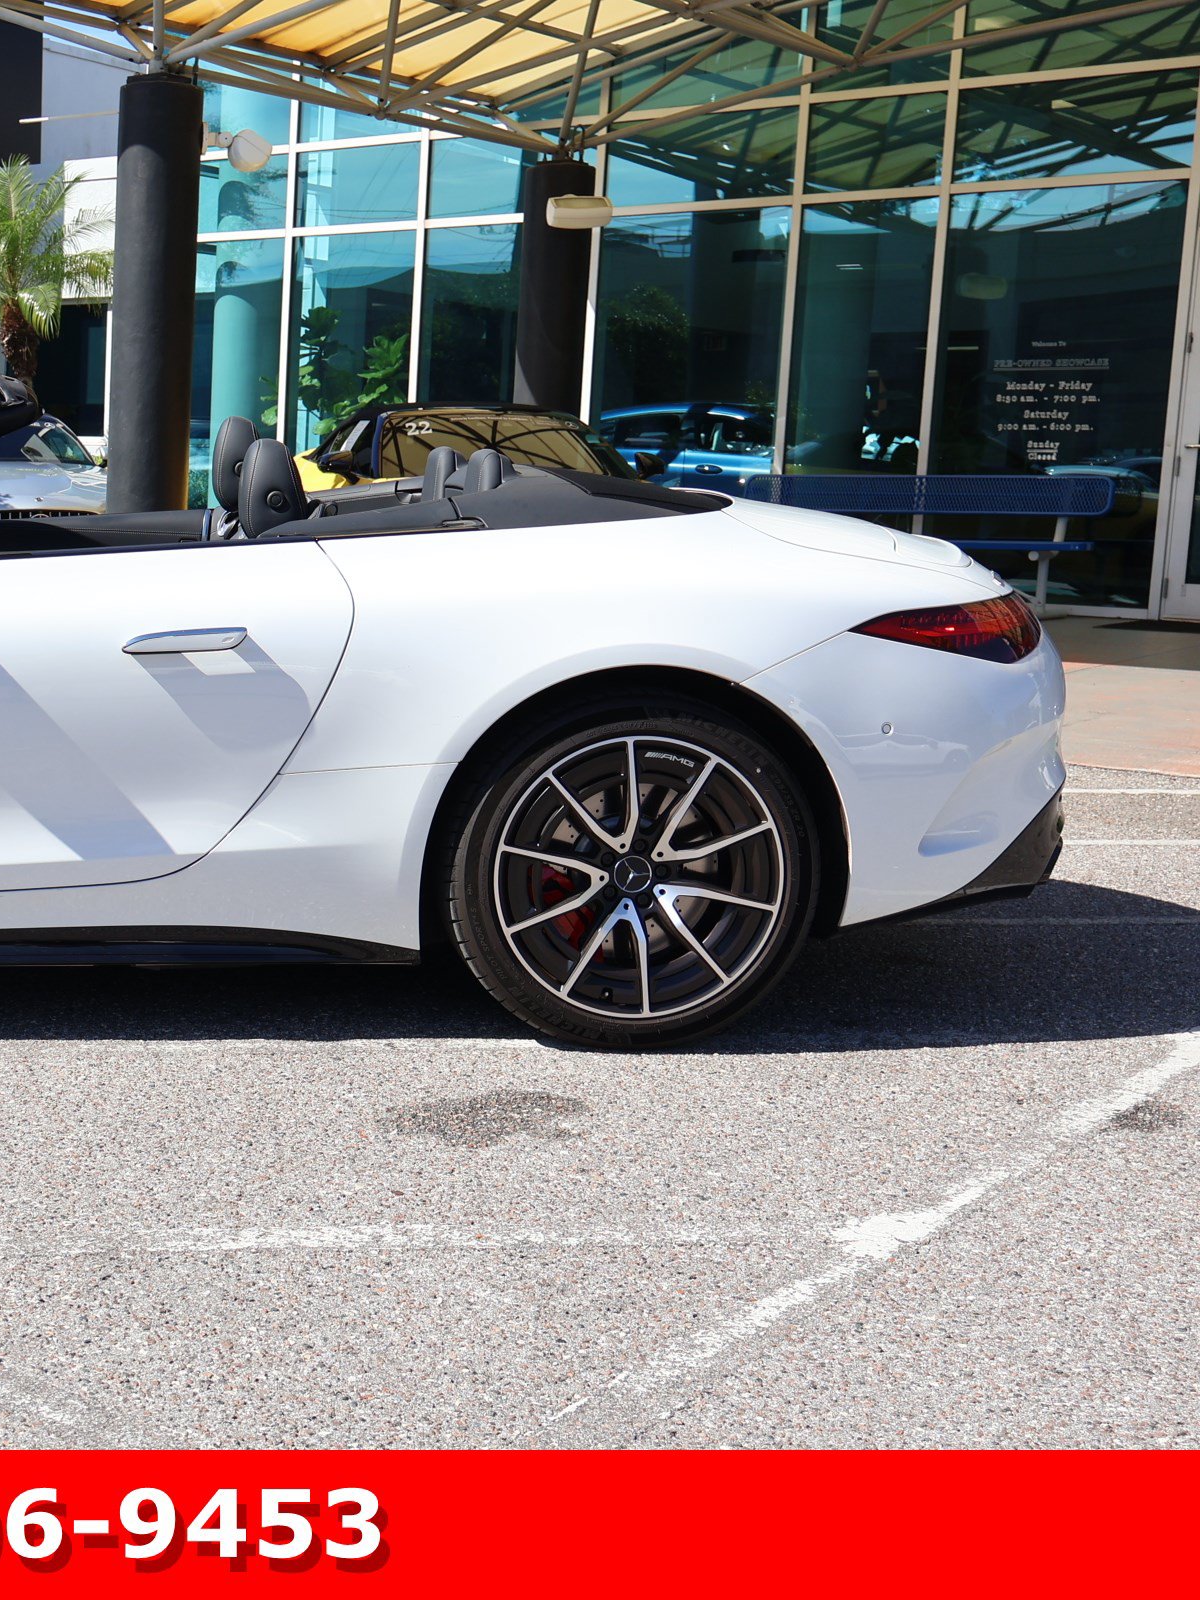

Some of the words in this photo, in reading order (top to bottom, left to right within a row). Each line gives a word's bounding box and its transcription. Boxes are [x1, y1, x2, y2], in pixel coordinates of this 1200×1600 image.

[994, 359, 1053, 368] PRE-OWNED
[1055, 358, 1109, 367] SHOWCASE
[1006, 381, 1046, 392] Monday
[1058, 381, 1093, 392] Friday
[995, 394, 1018, 404] 8:30
[1053, 395, 1077, 404] 7:00
[1081, 395, 1101, 404] pm.
[1023, 409, 1070, 420] Saturday
[405, 421, 433, 436] 22
[997, 423, 1019, 431] 9:00
[1049, 422, 1072, 431] 6:00
[1074, 423, 1094, 433] pm.
[1027, 440, 1060, 449] Sunday
[1028, 453, 1057, 461] Closed
[663, 753, 695, 768] AMG
